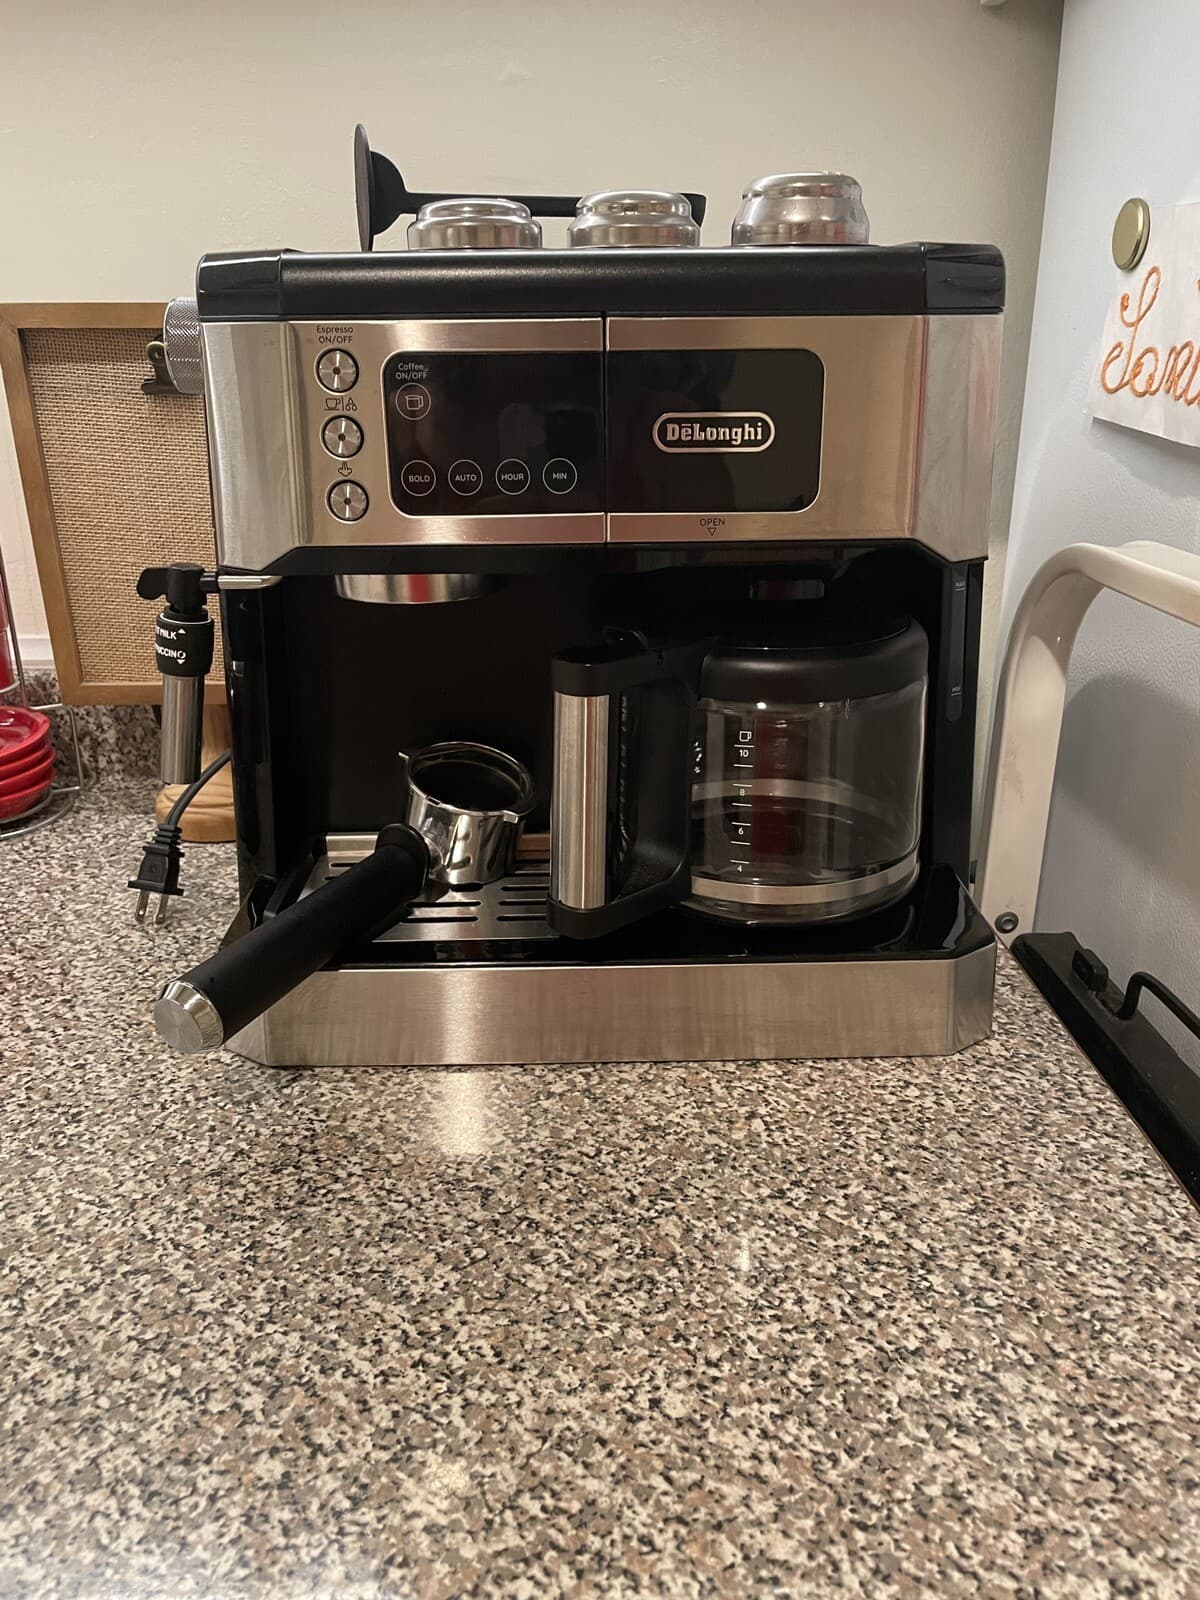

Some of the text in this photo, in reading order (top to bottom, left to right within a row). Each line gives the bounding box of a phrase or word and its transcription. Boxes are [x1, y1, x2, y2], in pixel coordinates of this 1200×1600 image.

[316, 326, 353, 335] Espresso
[318, 335, 353, 344] ON/OFF
[398, 362, 424, 371] Coffee
[395, 371, 428, 380] ON/OFF
[408, 474, 430, 483] BOLD
[455, 473, 477, 482] AUTO
[501, 472, 524, 481] HOUR
[552, 471, 567, 480] MIN
[699, 518, 725, 527] OPEN
[160, 628, 177, 640] MILK
[156, 643, 186, 659] UCCINO
[739, 749, 749, 758] 10
[739, 788, 745, 797] 8
[738, 827, 744, 835] 6
[736, 865, 743, 873] 4
